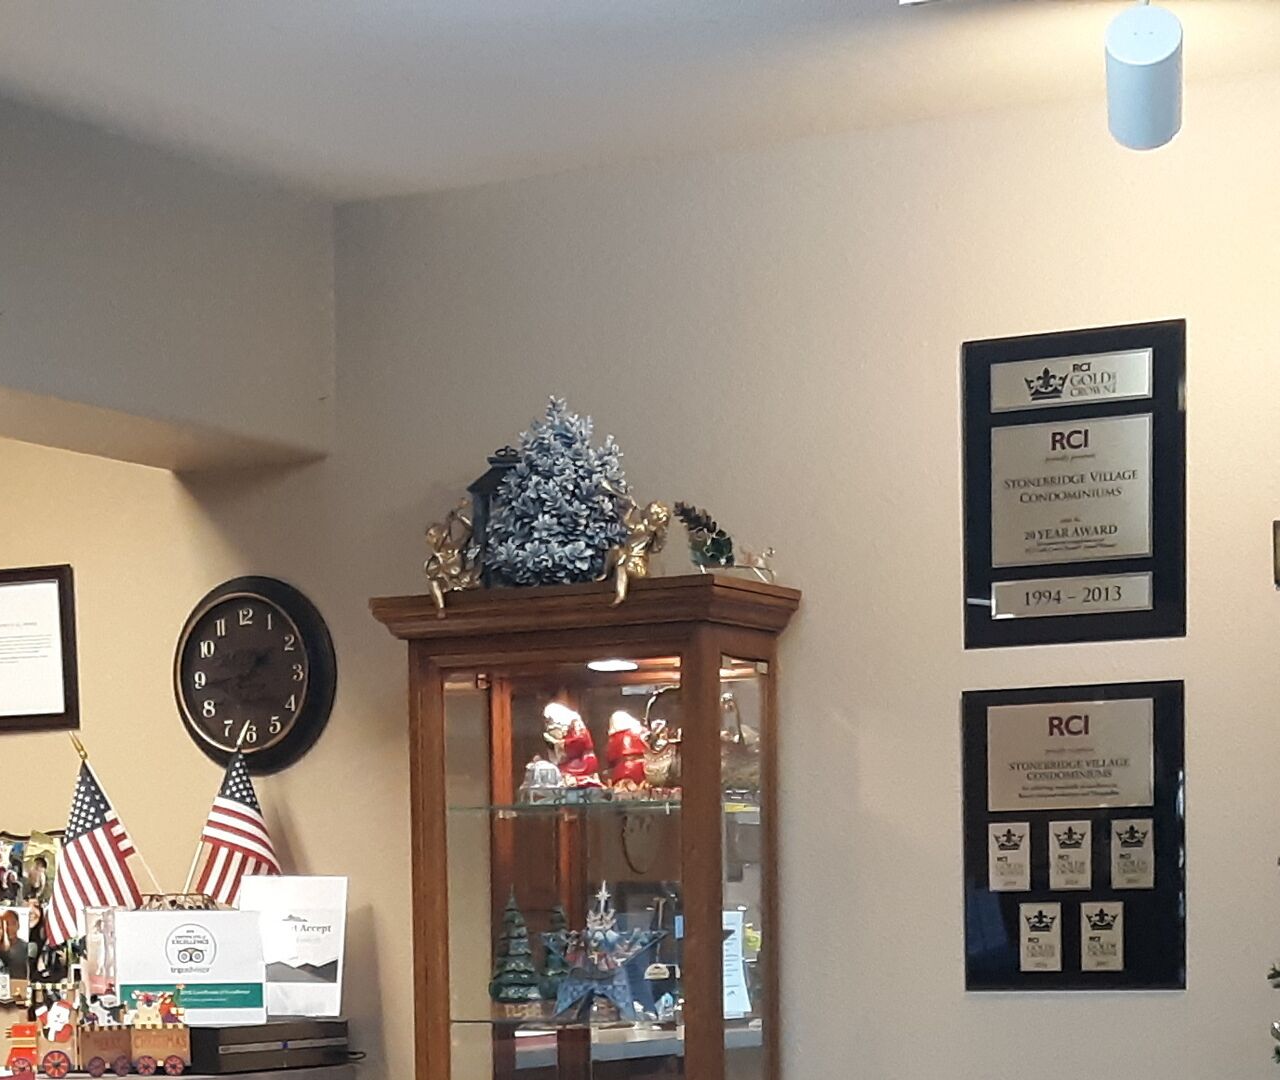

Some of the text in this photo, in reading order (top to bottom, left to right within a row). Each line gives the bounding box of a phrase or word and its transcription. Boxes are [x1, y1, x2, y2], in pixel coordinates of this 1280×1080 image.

[1071, 371, 1111, 387] GOLD
[1050, 429, 1089, 451] RCI
[1036, 527, 1070, 540] YEAR
[1070, 525, 1118, 538] AWARD
[1025, 590, 1061, 606] 1994
[1081, 585, 1122, 603] 2013
[239, 607, 253, 625] 12
[267, 613, 272, 630] 1
[216, 618, 225, 637] 11
[200, 640, 215, 658] 10
[284, 634, 295, 651] 2
[194, 671, 206, 689] 9
[292, 664, 304, 681] 3
[202, 699, 216, 718] 8
[285, 694, 296, 712] 4
[223, 720, 233, 737] 7
[246, 725, 257, 743] 6
[269, 716, 281, 734] 5
[1048, 714, 1090, 737] RCI
